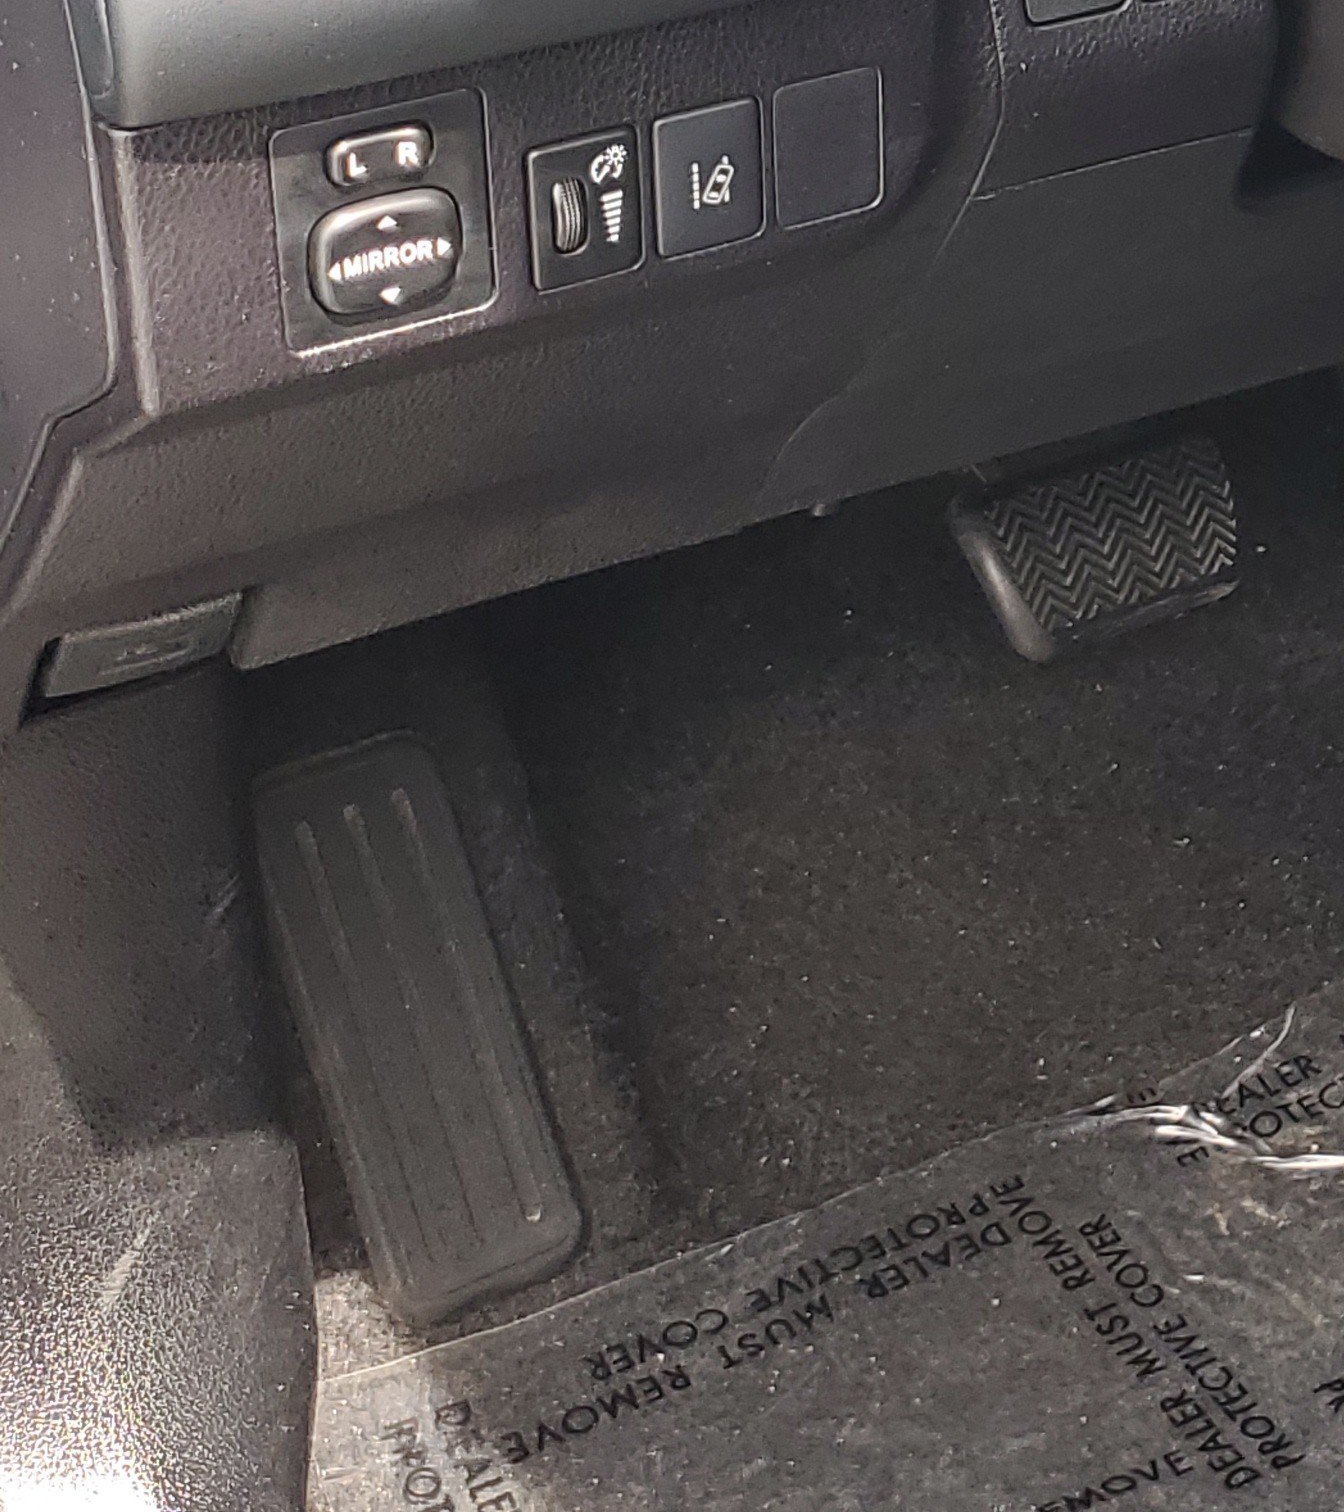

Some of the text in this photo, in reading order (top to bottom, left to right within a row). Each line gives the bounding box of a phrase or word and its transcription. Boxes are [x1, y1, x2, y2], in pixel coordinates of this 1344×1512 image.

[343, 238, 435, 279] MIRROR
[347, 139, 421, 178] L R
[499, 1219, 1012, 1466] DEALER MUST REMOVE
[581, 1191, 993, 1384] PROTECTIVE COVER
[988, 1172, 1263, 1490] DEALER MUST REMOVE
[1079, 1212, 1306, 1472] PROTECTIVE COVER
